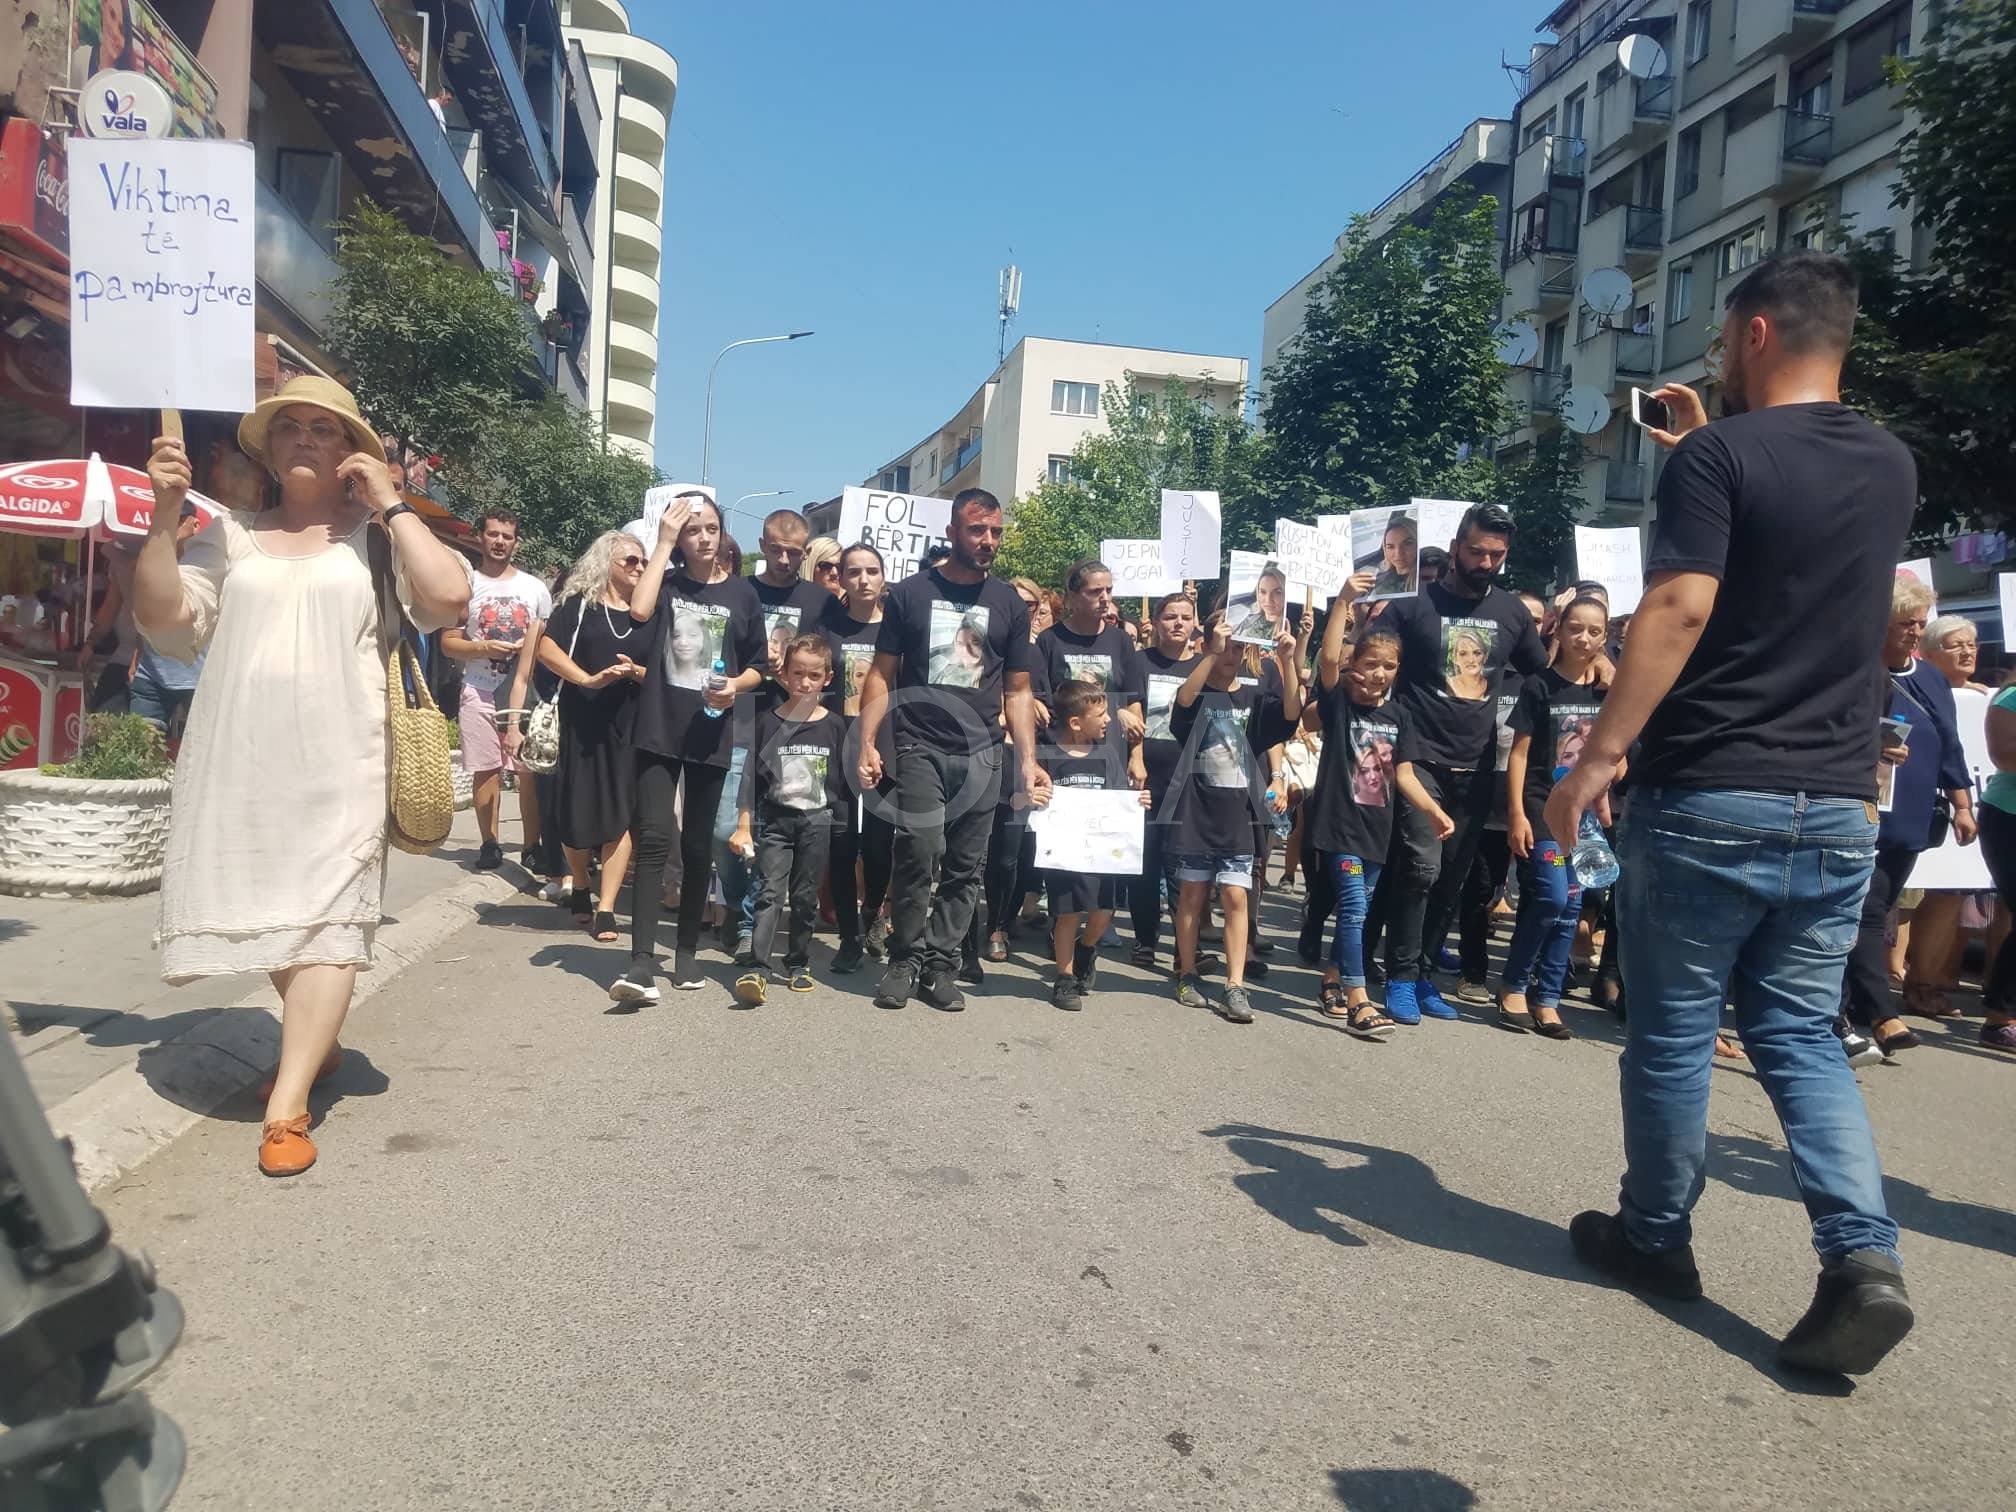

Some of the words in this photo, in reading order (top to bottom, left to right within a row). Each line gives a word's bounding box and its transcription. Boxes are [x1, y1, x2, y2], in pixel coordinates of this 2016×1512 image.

[103, 112, 147, 132] vala
[99, 161, 239, 223] Viktima
[865, 493, 926, 528] FOL
